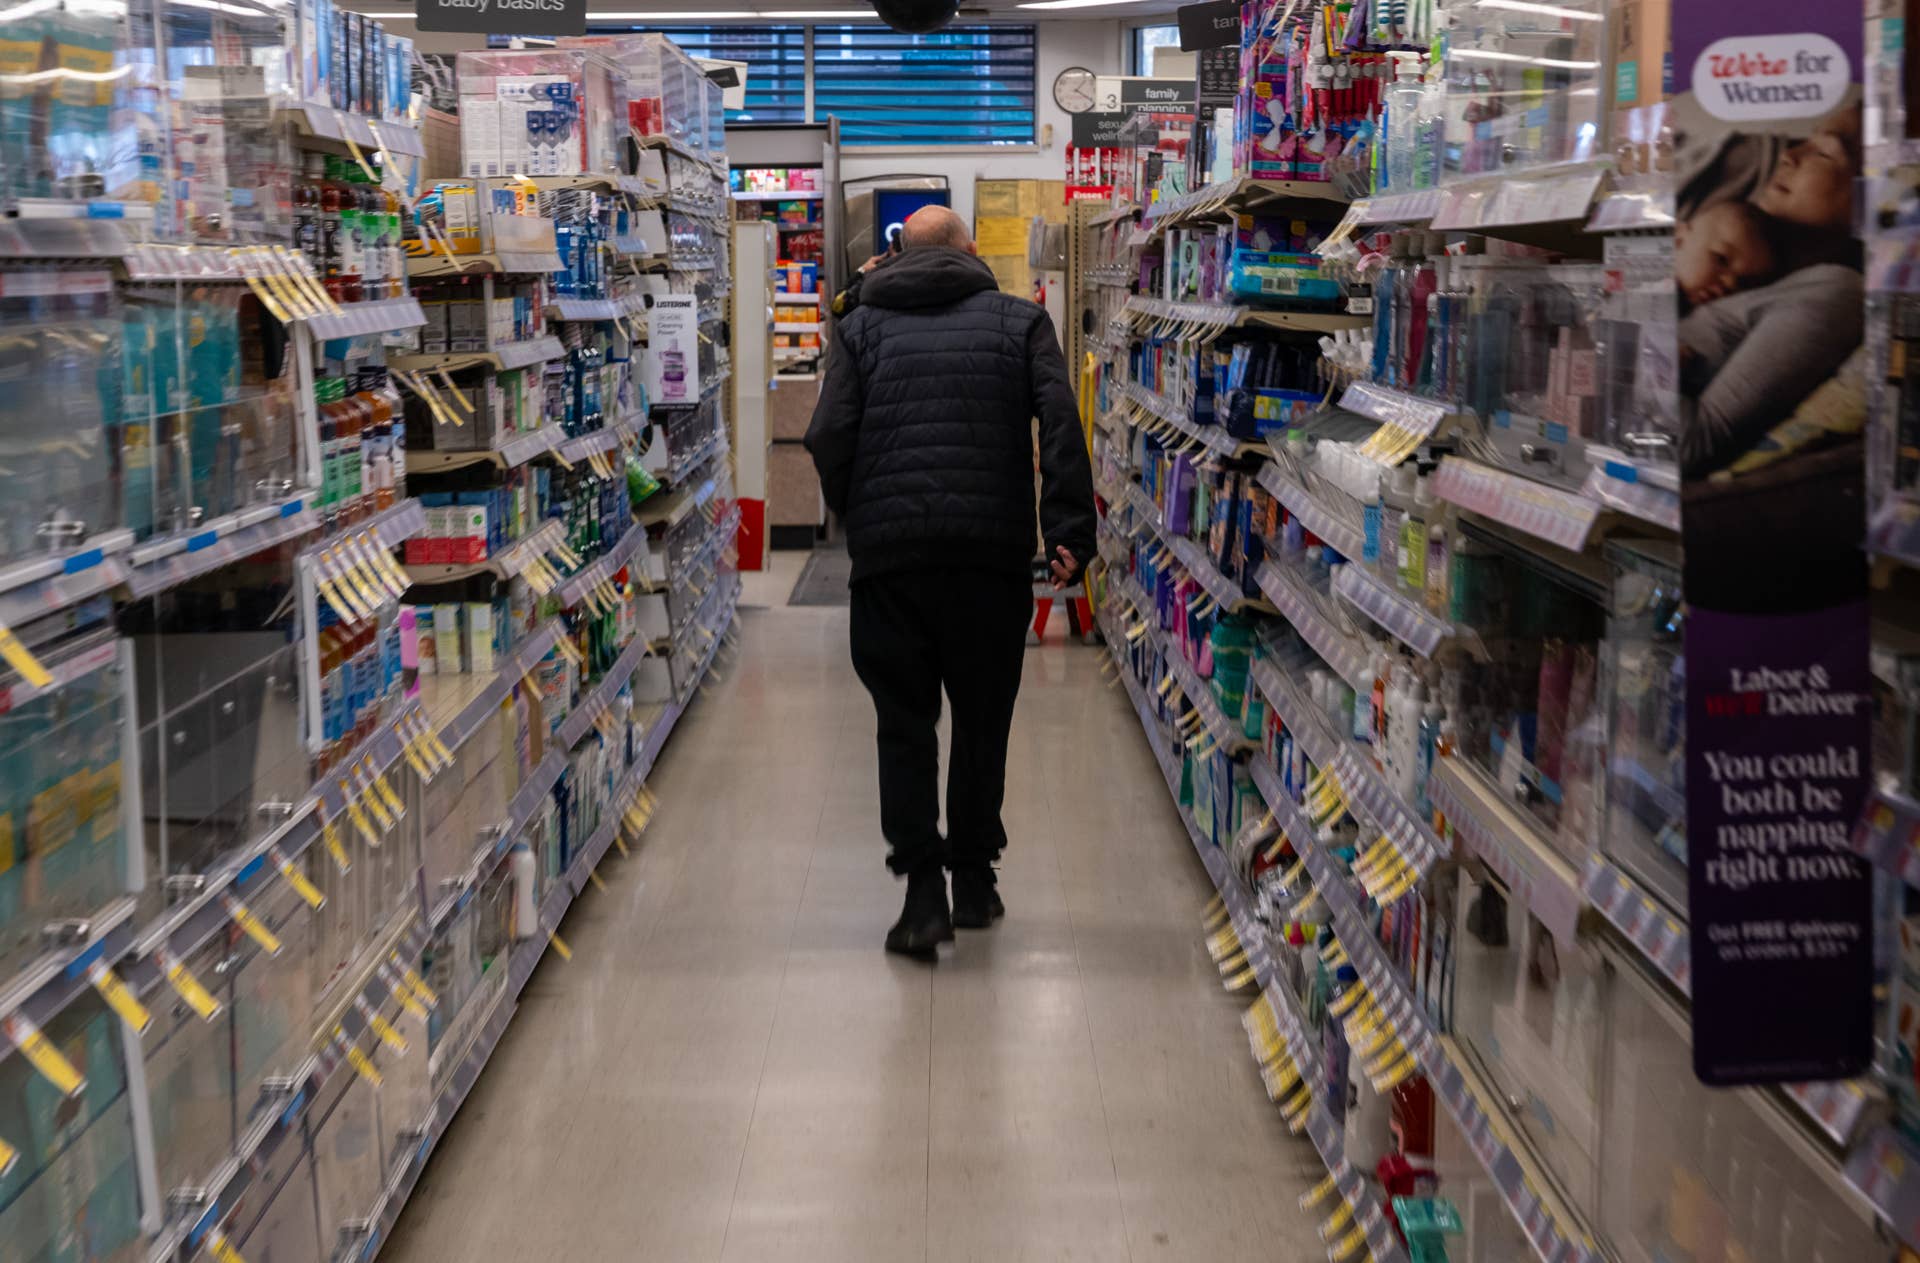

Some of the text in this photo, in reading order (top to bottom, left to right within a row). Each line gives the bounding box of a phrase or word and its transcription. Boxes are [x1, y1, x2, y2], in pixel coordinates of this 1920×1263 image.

[1709, 51, 1832, 78] We're for
[1106, 94, 1117, 109] 3
[1145, 87, 1179, 100] family
[1722, 82, 1823, 103] Women
[1730, 664, 1830, 692] Labor &
[1767, 690, 1856, 715] Deliver
[1704, 746, 1859, 781] You could
[1722, 780, 1842, 814] both be
[1718, 815, 1850, 853] napping
[1705, 852, 1779, 890] right
